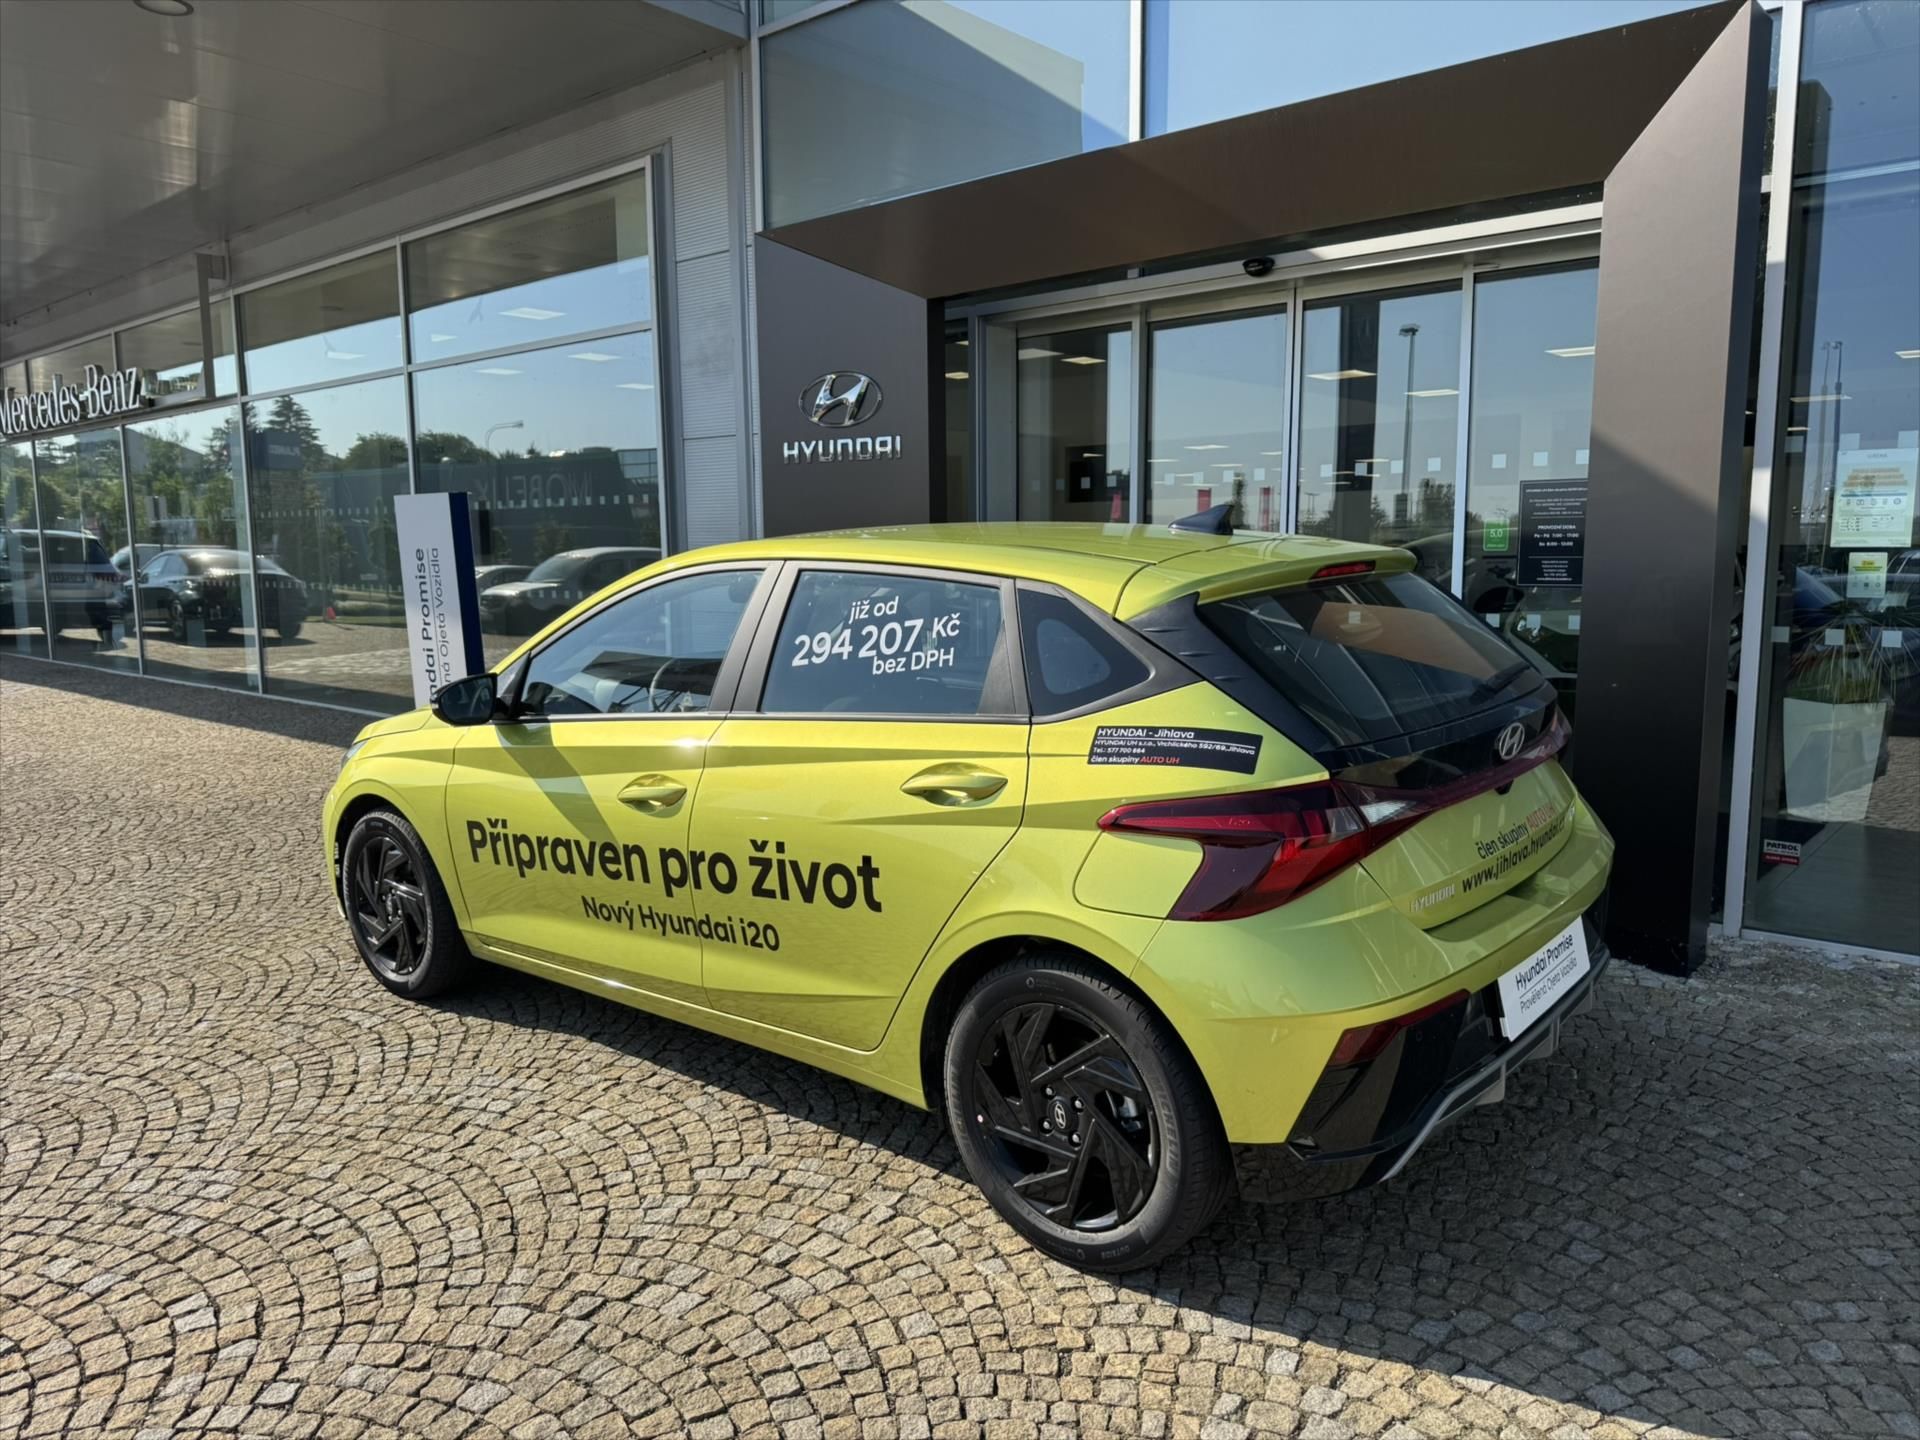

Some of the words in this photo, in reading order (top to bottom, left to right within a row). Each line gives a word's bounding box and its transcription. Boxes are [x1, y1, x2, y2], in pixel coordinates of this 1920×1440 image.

[783, 435, 901, 464] HYUNDAI
[414, 548, 433, 641] Promise
[430, 547, 445, 608] Vozidla
[848, 600, 870, 624] již
[873, 596, 899, 617] od
[437, 613, 450, 657] Ojetá
[791, 628, 853, 667] 294
[858, 618, 924, 658] 207
[932, 612, 961, 638] Kč
[872, 655, 907, 675] bez
[911, 647, 955, 671] DPH
[1097, 728, 1147, 737] HYUNDAI
[1154, 729, 1195, 739] Jihlava
[1090, 755, 1108, 763] člen
[1108, 755, 1140, 765] skupiny
[1475, 840, 1500, 860] člen
[1499, 822, 1530, 849] skupiny
[1766, 841, 1799, 852] PATROL
[465, 817, 651, 884] Připraven
[659, 847, 738, 898] pro
[748, 839, 882, 913] život
[581, 895, 634, 931] Nový
[638, 906, 736, 945] Hyundai
[740, 918, 781, 952] i20
[1516, 952, 1548, 991] Hyundai
[1546, 934, 1573, 965] Promise
